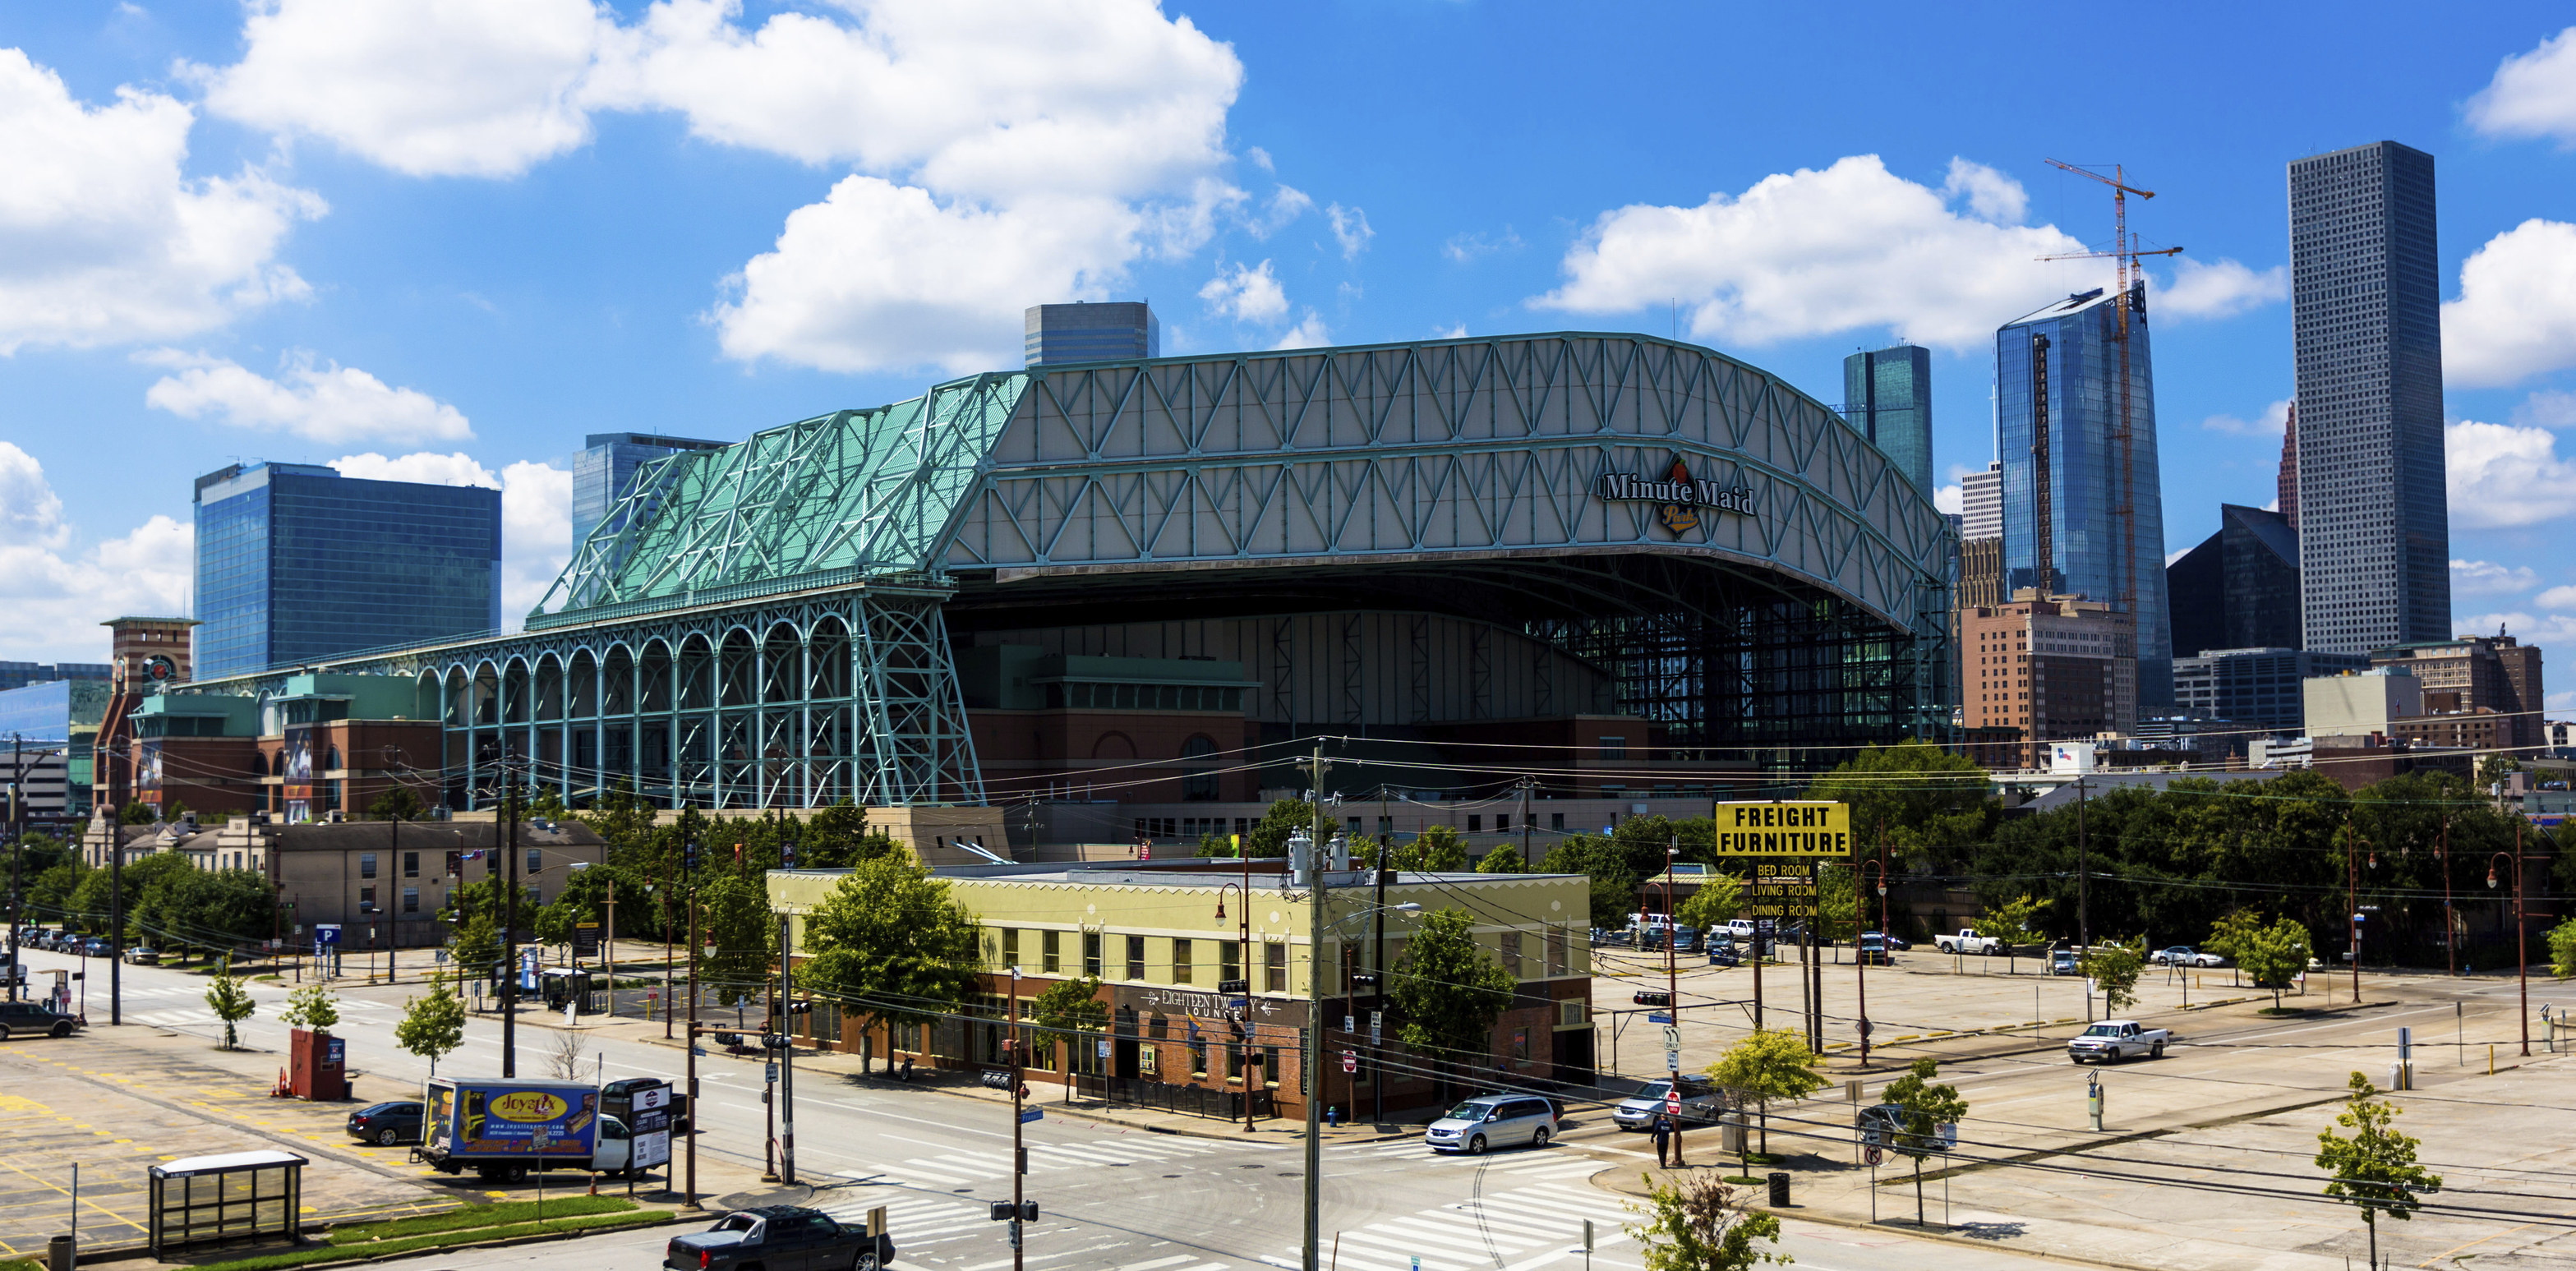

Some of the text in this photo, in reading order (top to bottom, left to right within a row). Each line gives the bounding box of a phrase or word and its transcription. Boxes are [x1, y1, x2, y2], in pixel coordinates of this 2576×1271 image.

[1606, 474, 1754, 515] Minute Maid
[1662, 504, 1696, 525] Park
[1735, 807, 1829, 827] FREIGHT
[1721, 832, 1846, 852] FURNITURE
[1758, 864, 1810, 876] BED ROOM
[1752, 885, 1817, 896] LIVING ROOM
[1752, 905, 1818, 917] DINING ROOM
[325, 930, 333, 941] P
[1162, 990, 1210, 1008] EIGHTEEN
[502, 1094, 556, 1113] Joystix
[1022, 1110, 1043, 1122] Franklin
